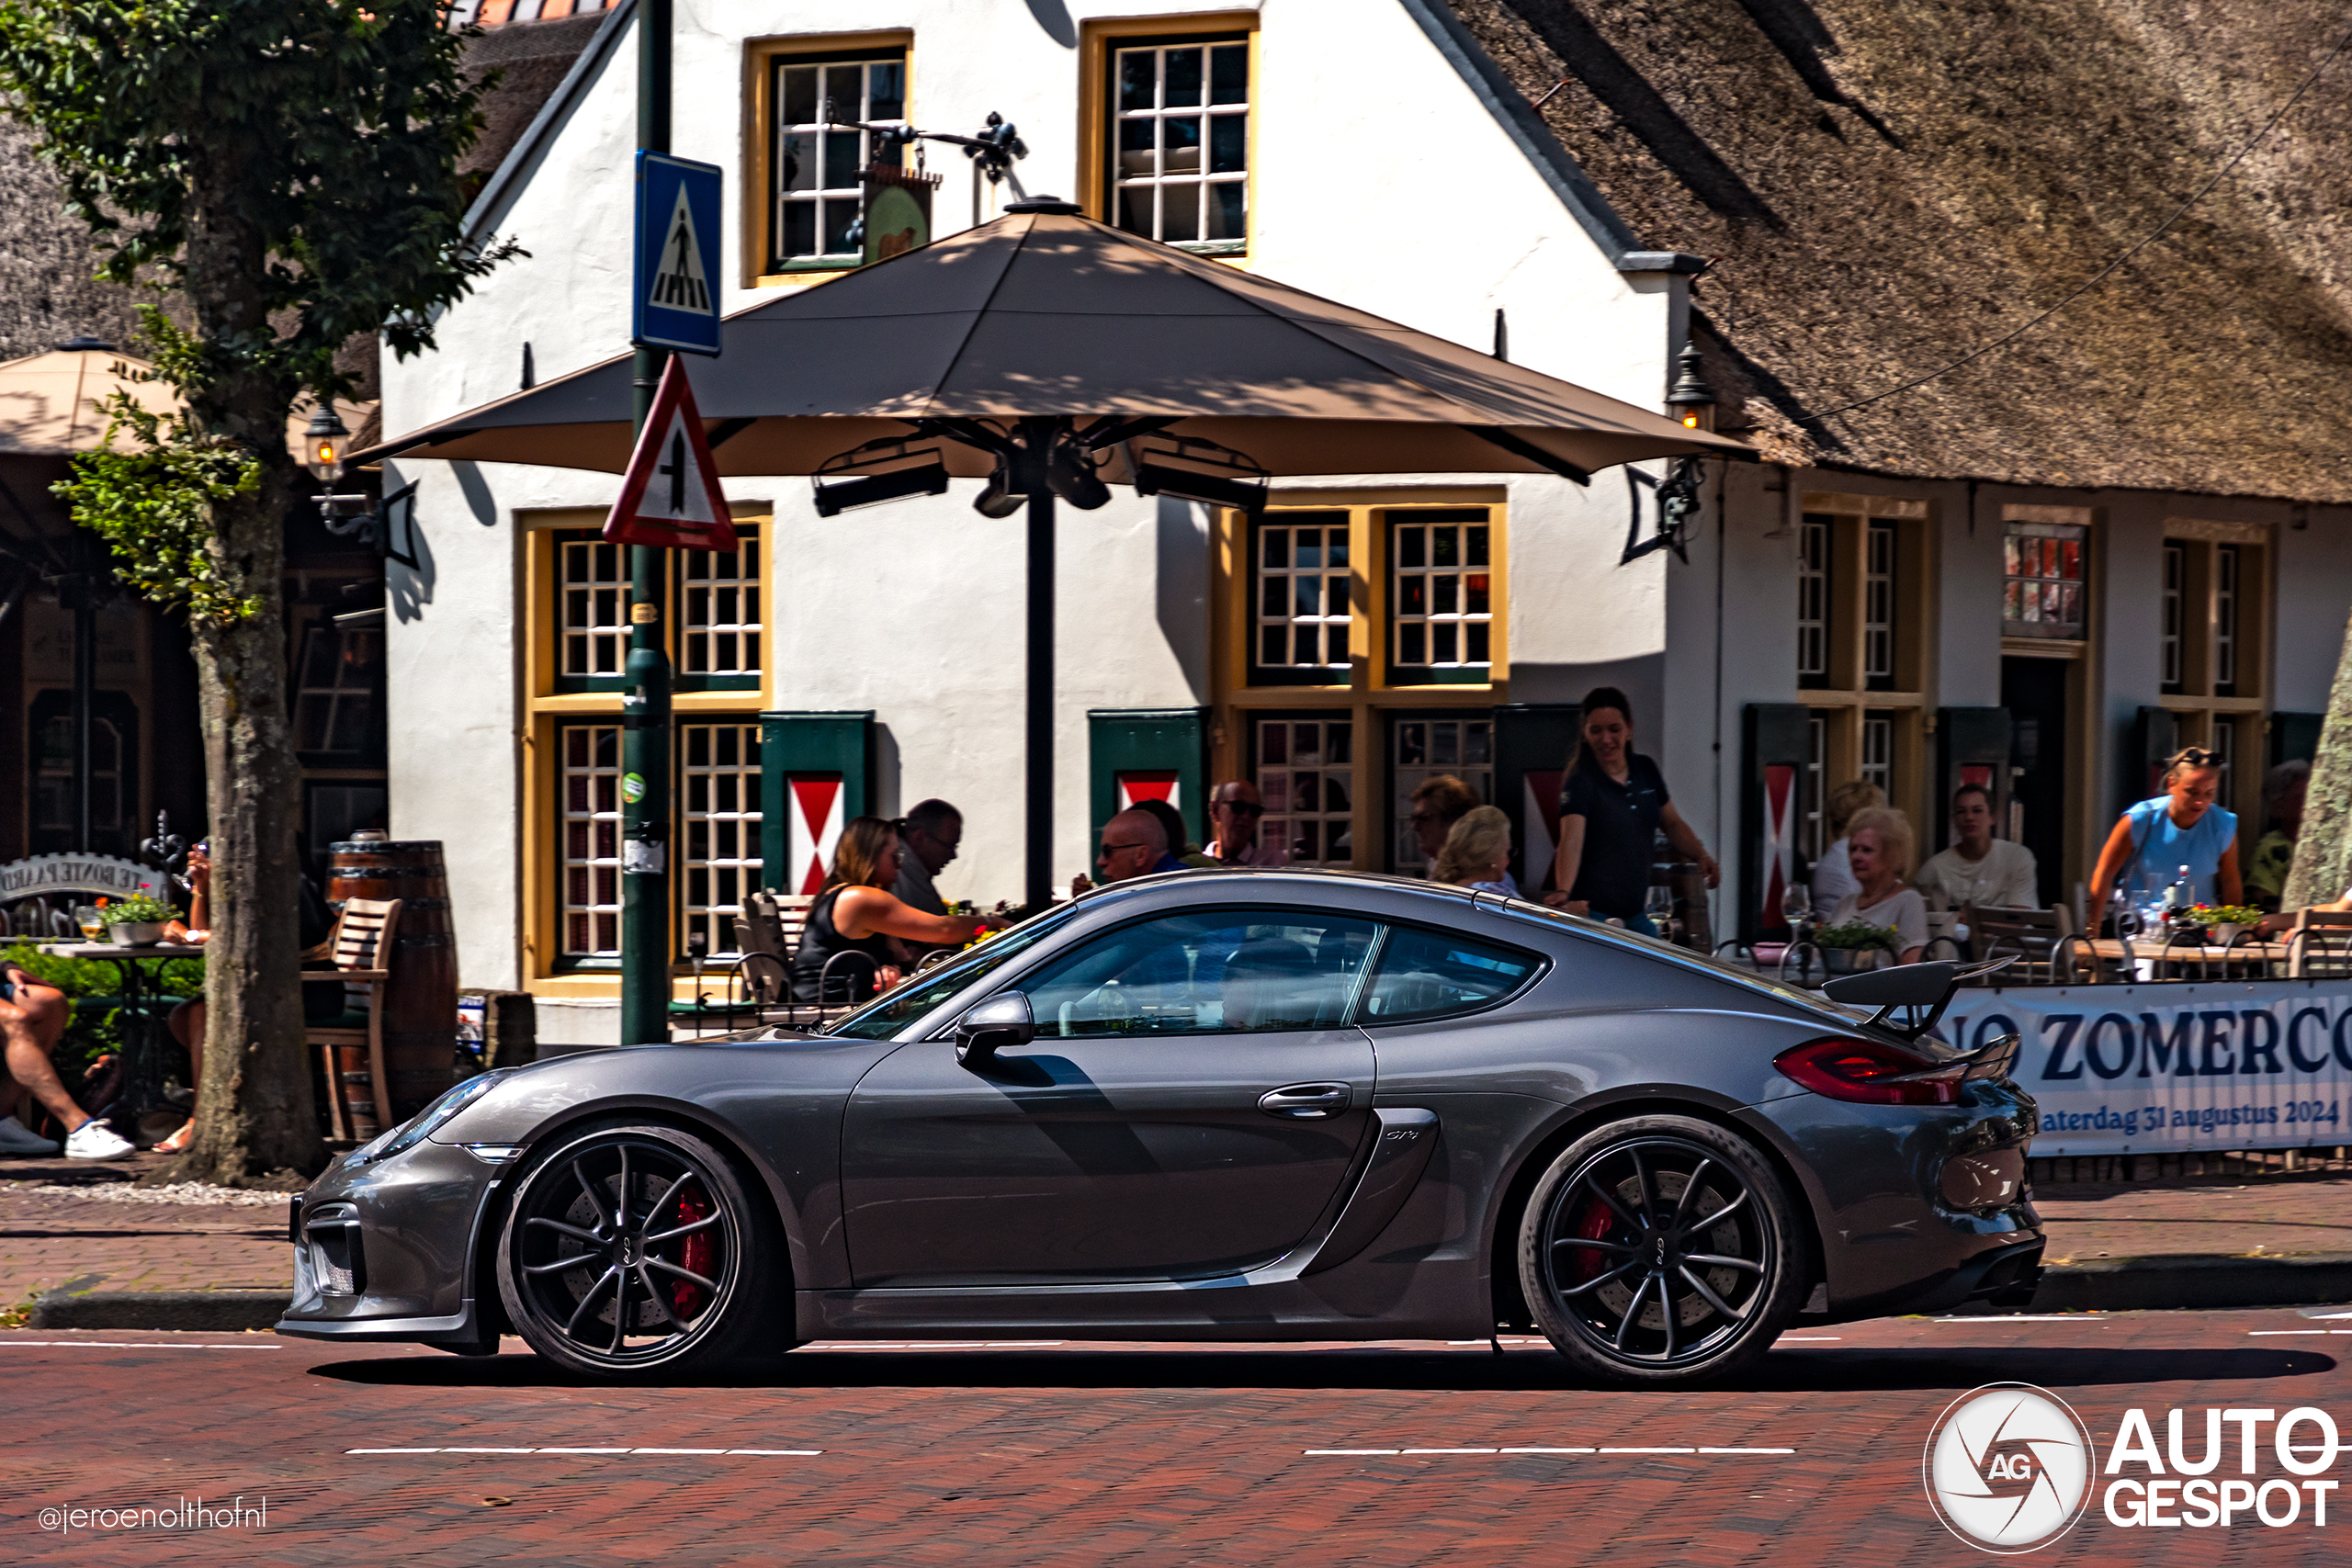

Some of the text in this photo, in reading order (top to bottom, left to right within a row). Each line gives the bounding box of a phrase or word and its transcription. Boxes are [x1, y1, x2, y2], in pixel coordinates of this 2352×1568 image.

[2039, 1100, 2339, 1136] aterdag 31 augustus 2024
